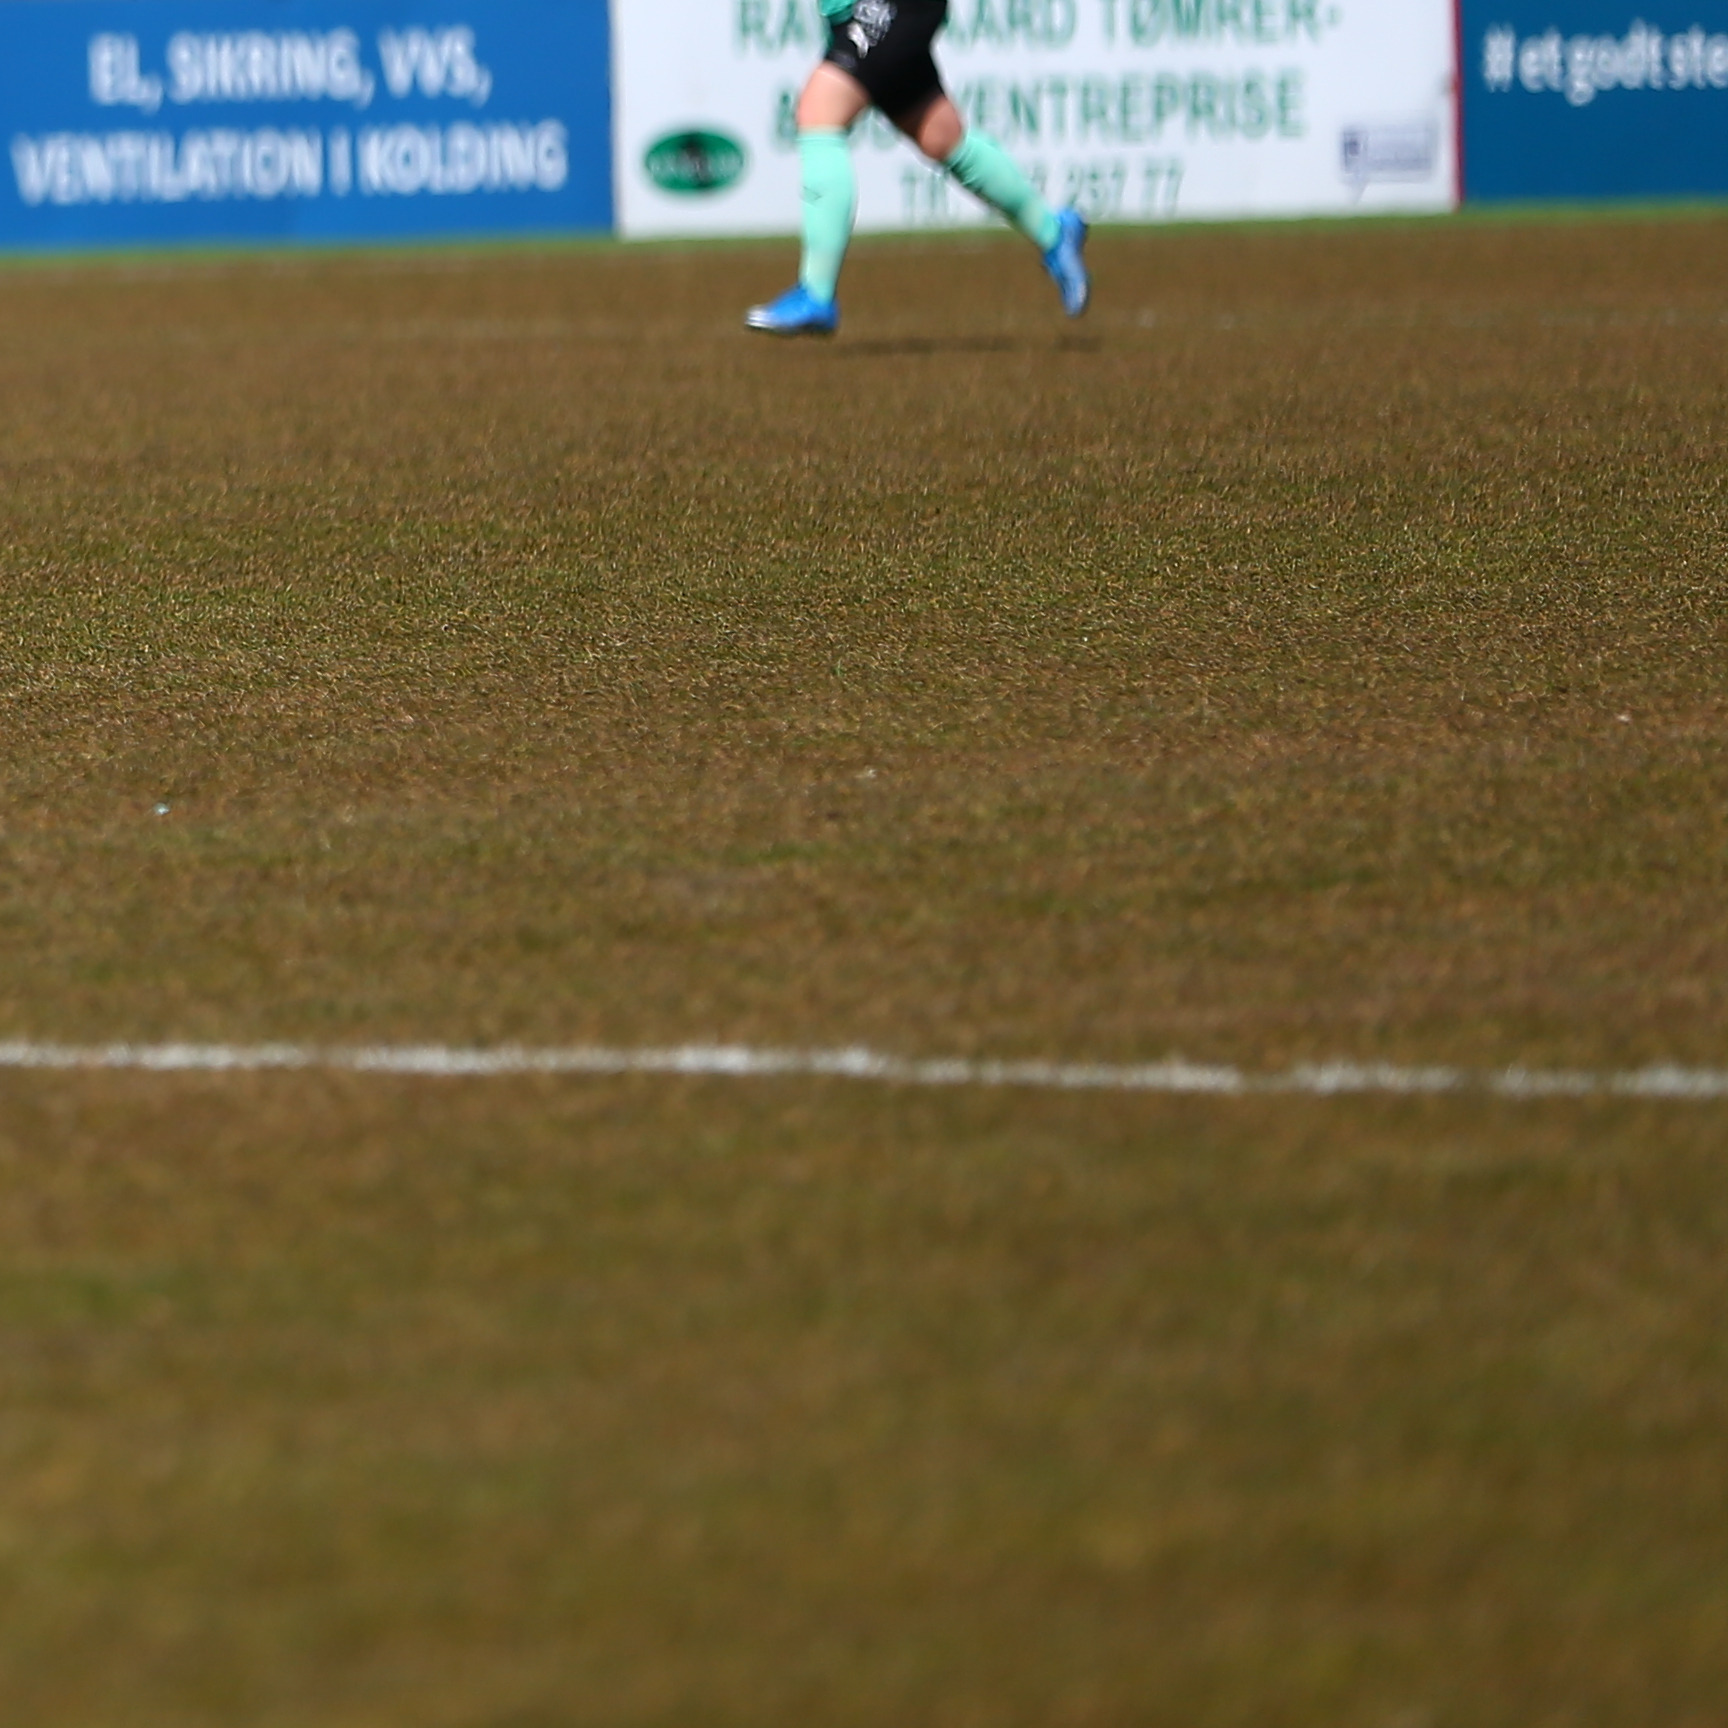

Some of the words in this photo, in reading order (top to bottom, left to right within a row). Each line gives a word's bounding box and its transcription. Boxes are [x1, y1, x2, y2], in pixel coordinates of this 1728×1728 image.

[88, 30, 163, 115] EL,
[166, 26, 376, 112] SIKRING,
[378, 24, 494, 108] VVS,
[10, 126, 323, 206] VENTILATION
[328, 125, 352, 198] I
[359, 117, 569, 197] KOLDING
